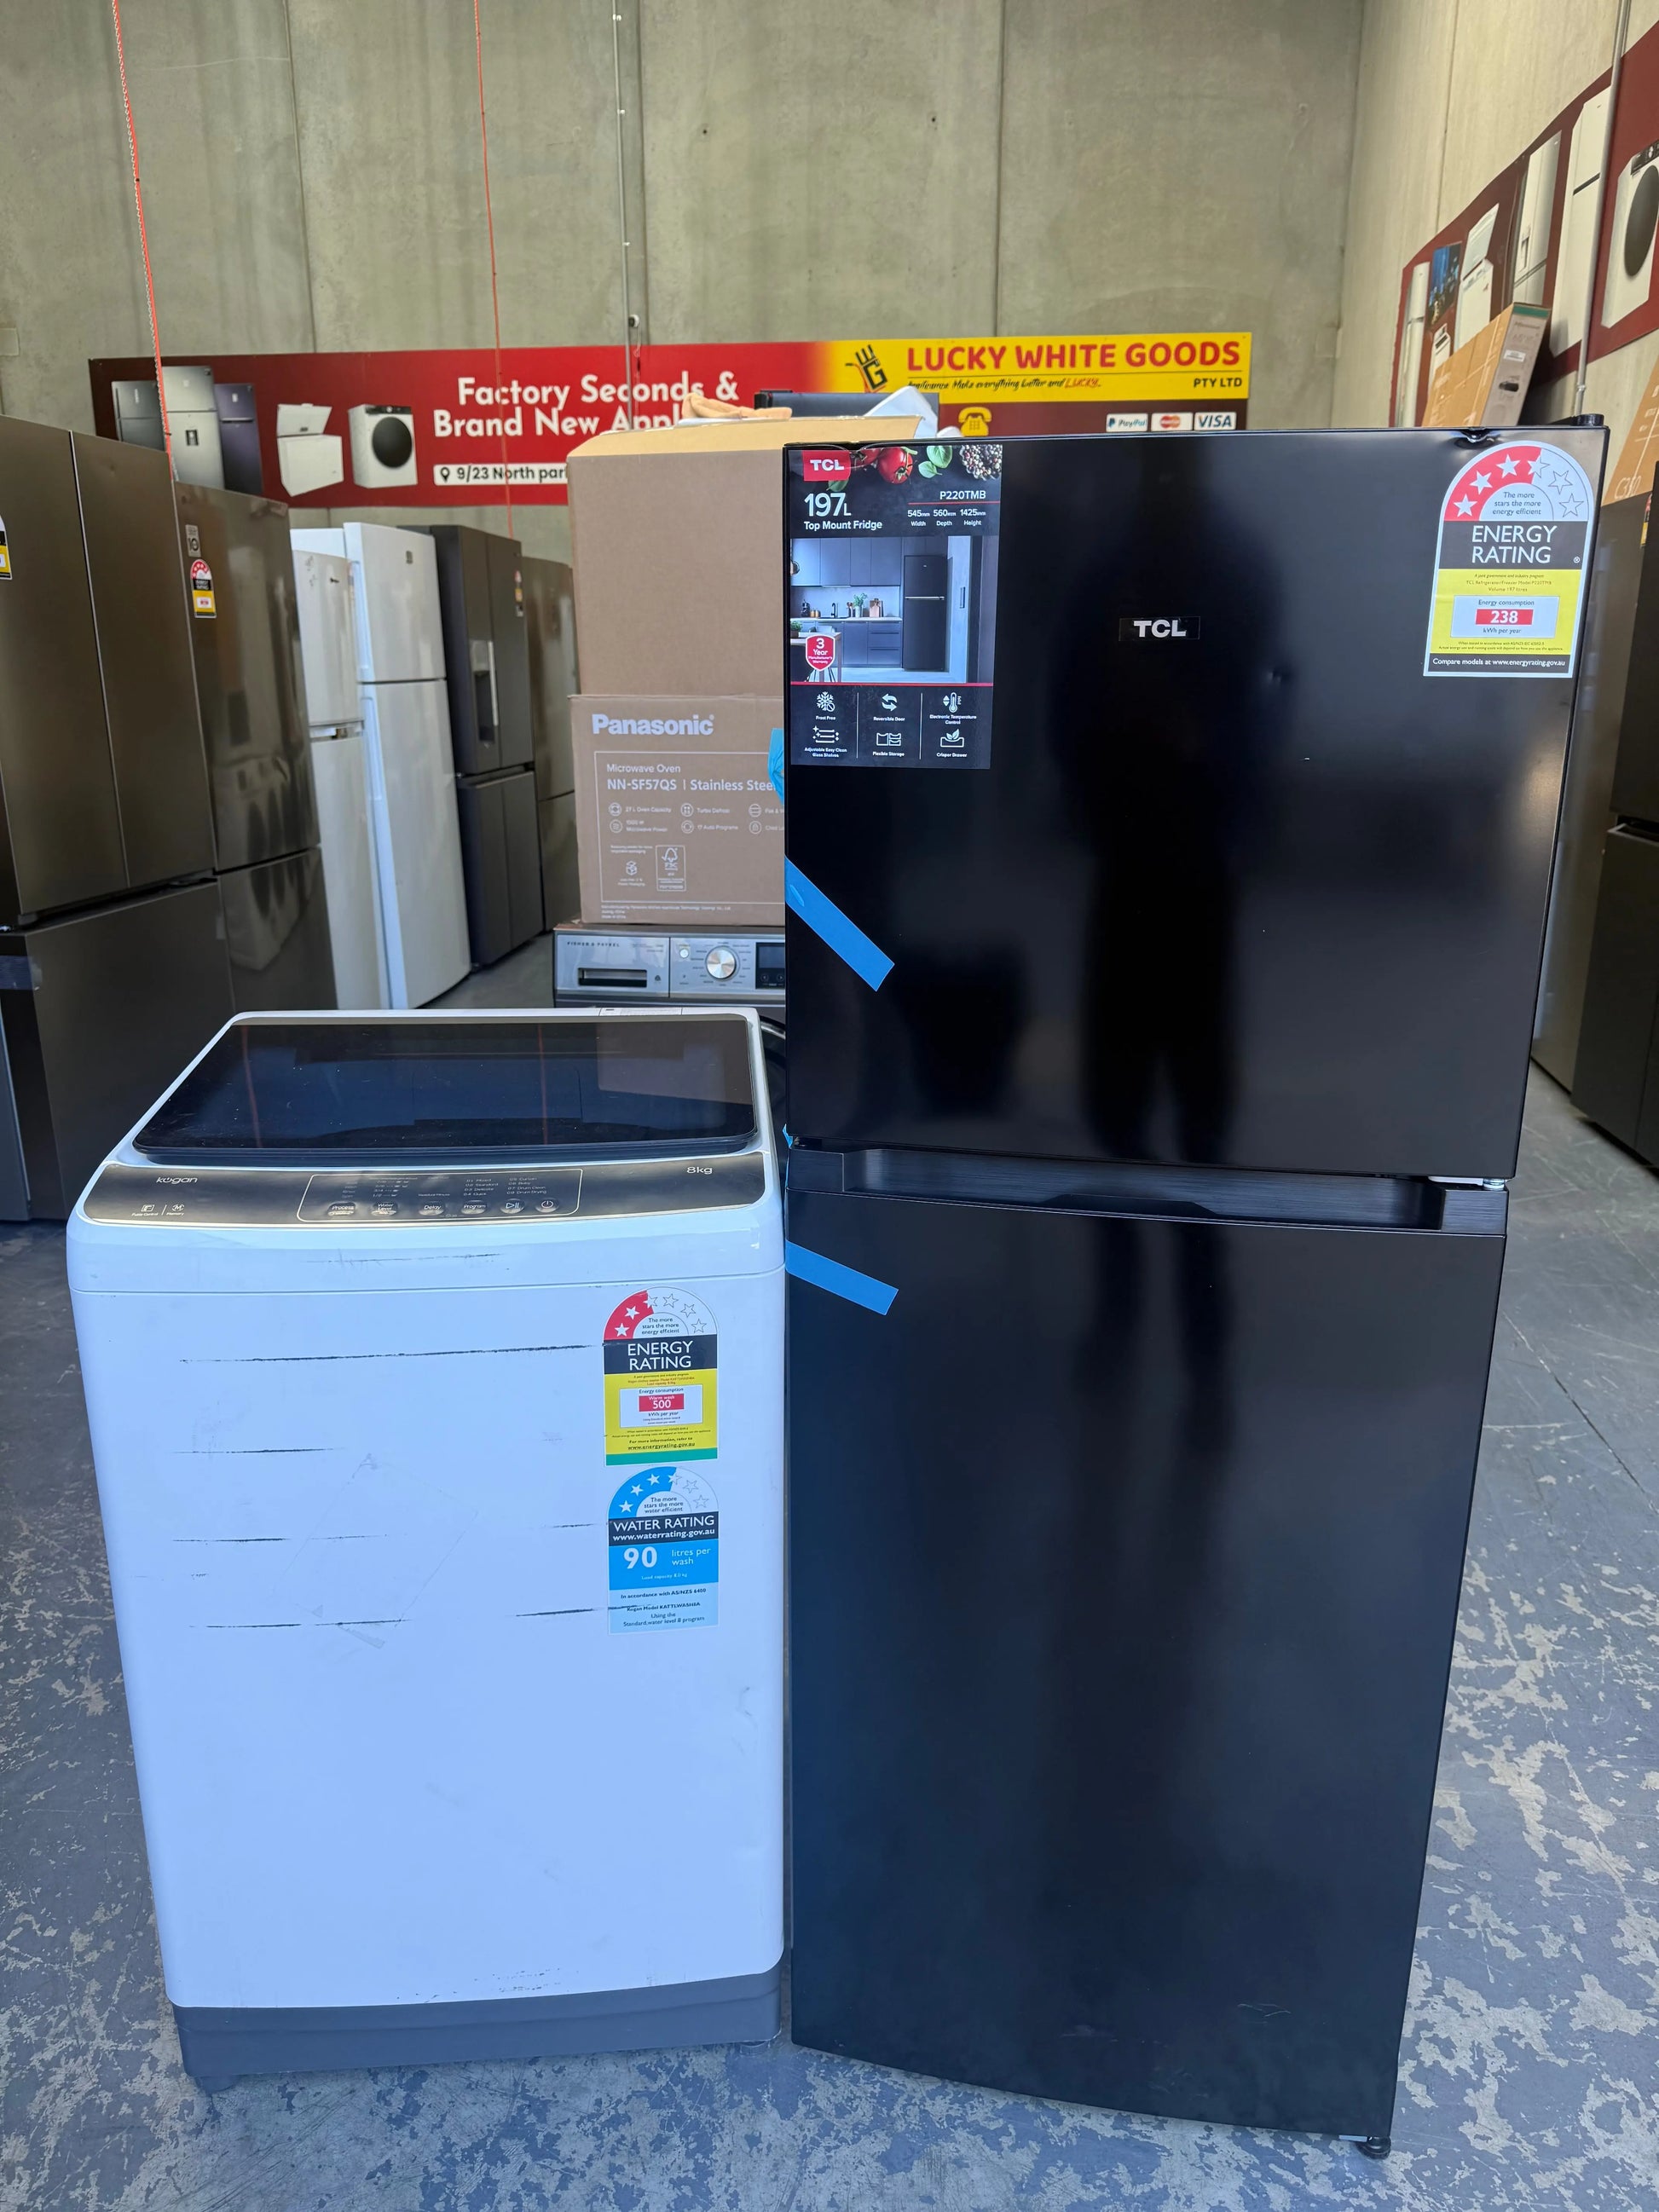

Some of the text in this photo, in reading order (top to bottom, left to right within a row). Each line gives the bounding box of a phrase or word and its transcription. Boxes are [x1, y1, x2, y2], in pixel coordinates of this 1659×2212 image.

[908, 341, 1241, 372] LUCKY WHITE GOODS
[1194, 377, 1242, 388] PTY LTD
[457, 371, 739, 411] Factory Seconds &
[433, 403, 681, 438] Brand New Appl
[1119, 415, 1233, 428] PayPal VISA
[810, 459, 845, 471] TCL
[457, 466, 568, 485] 9/23 North par
[939, 490, 986, 500] P220TMB
[804, 521, 821, 531] Top
[822, 520, 852, 530] Mount
[853, 520, 883, 530] Fridge
[1471, 525, 1558, 543] ENERGY
[1471, 546, 1552, 563] RATING
[1490, 610, 1518, 624] 238
[1133, 619, 1187, 638] TCL
[816, 638, 824, 649] 3
[1492, 659, 1566, 667] www.energyrating.gov.au
[592, 713, 714, 736] Panasonic
[606, 764, 680, 773] Microwave Oven
[607, 778, 677, 792] NN-SF57QS
[691, 778, 743, 791] Stainless
[686, 1166, 713, 1175] 8kg
[156, 1176, 198, 1185] kogan
[627, 1340, 693, 1356] ENERGY
[629, 1355, 691, 1371] RATING
[652, 1400, 672, 1409] 500
[628, 1442, 696, 1451] www.energyrating.gov.au
[613, 1516, 714, 1532] WATER RATING
[613, 1528, 715, 1541] www.waterrating.gov.au
[623, 1546, 657, 1569] 90
[696, 1548, 711, 1557] per
[672, 1557, 694, 1566] wash
